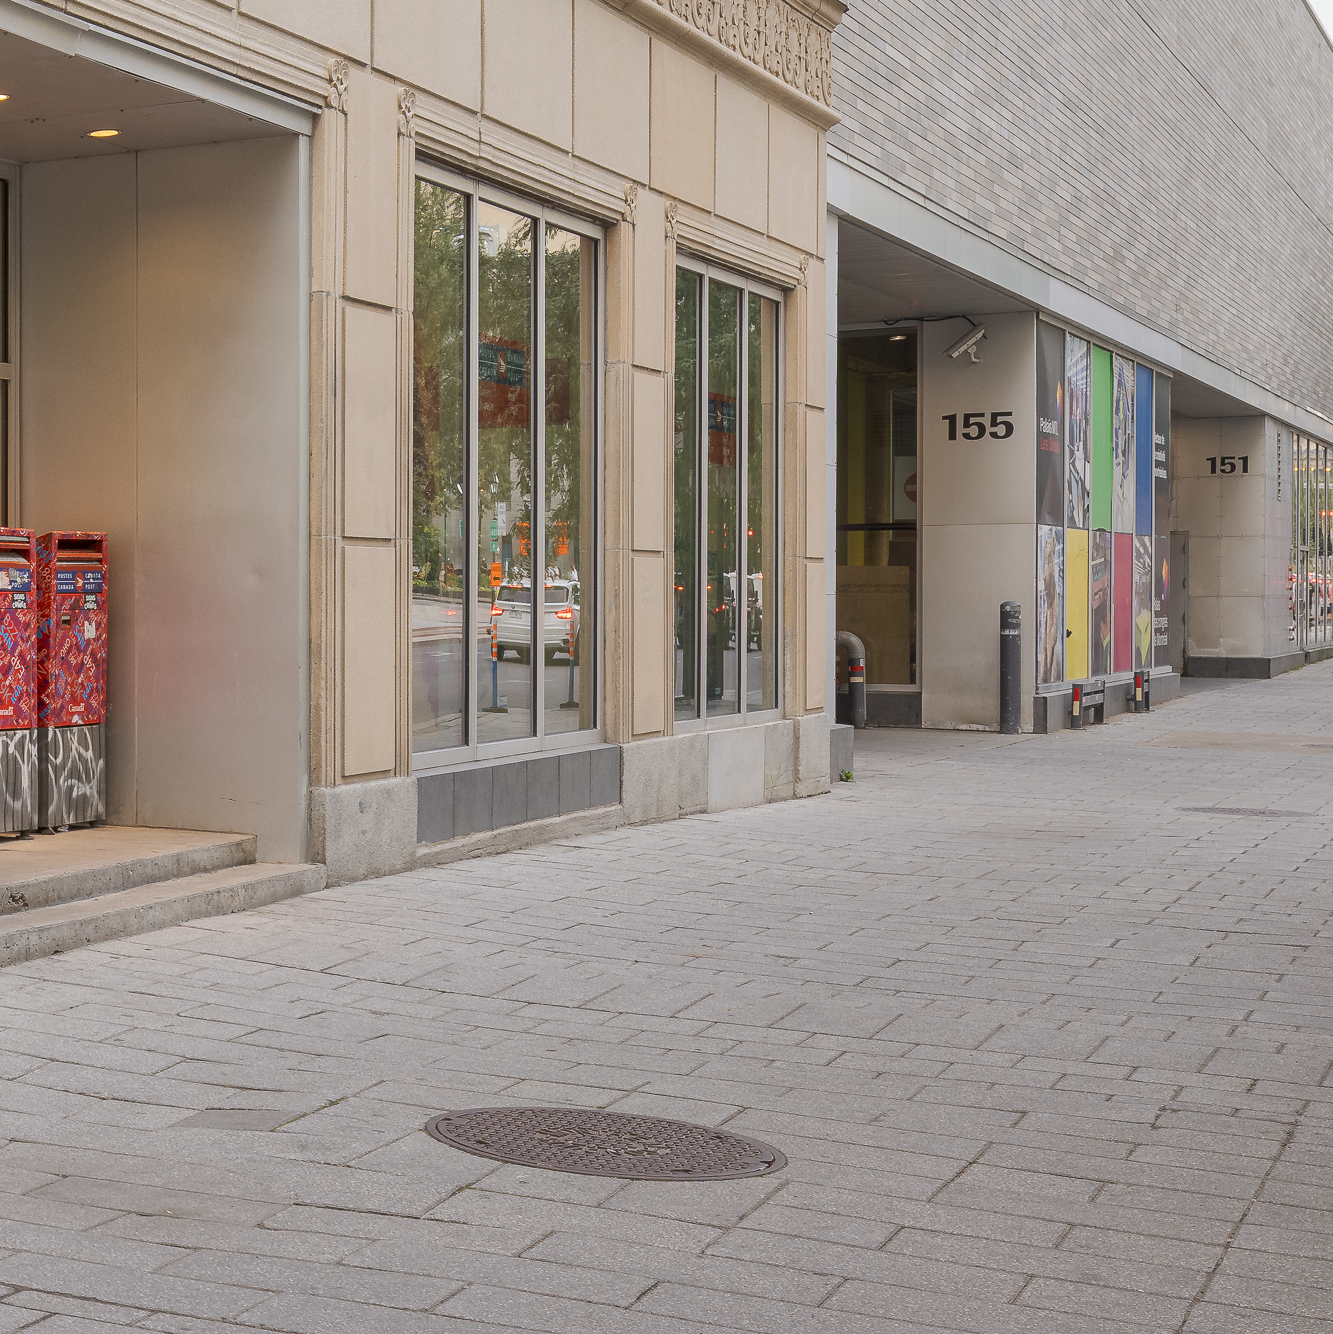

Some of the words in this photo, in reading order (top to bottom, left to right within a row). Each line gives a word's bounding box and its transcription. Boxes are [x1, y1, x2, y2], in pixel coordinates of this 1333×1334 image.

[941, 411, 1016, 441] 155
[1206, 455, 1250, 475] 151
[68, 703, 85, 712] Canada
